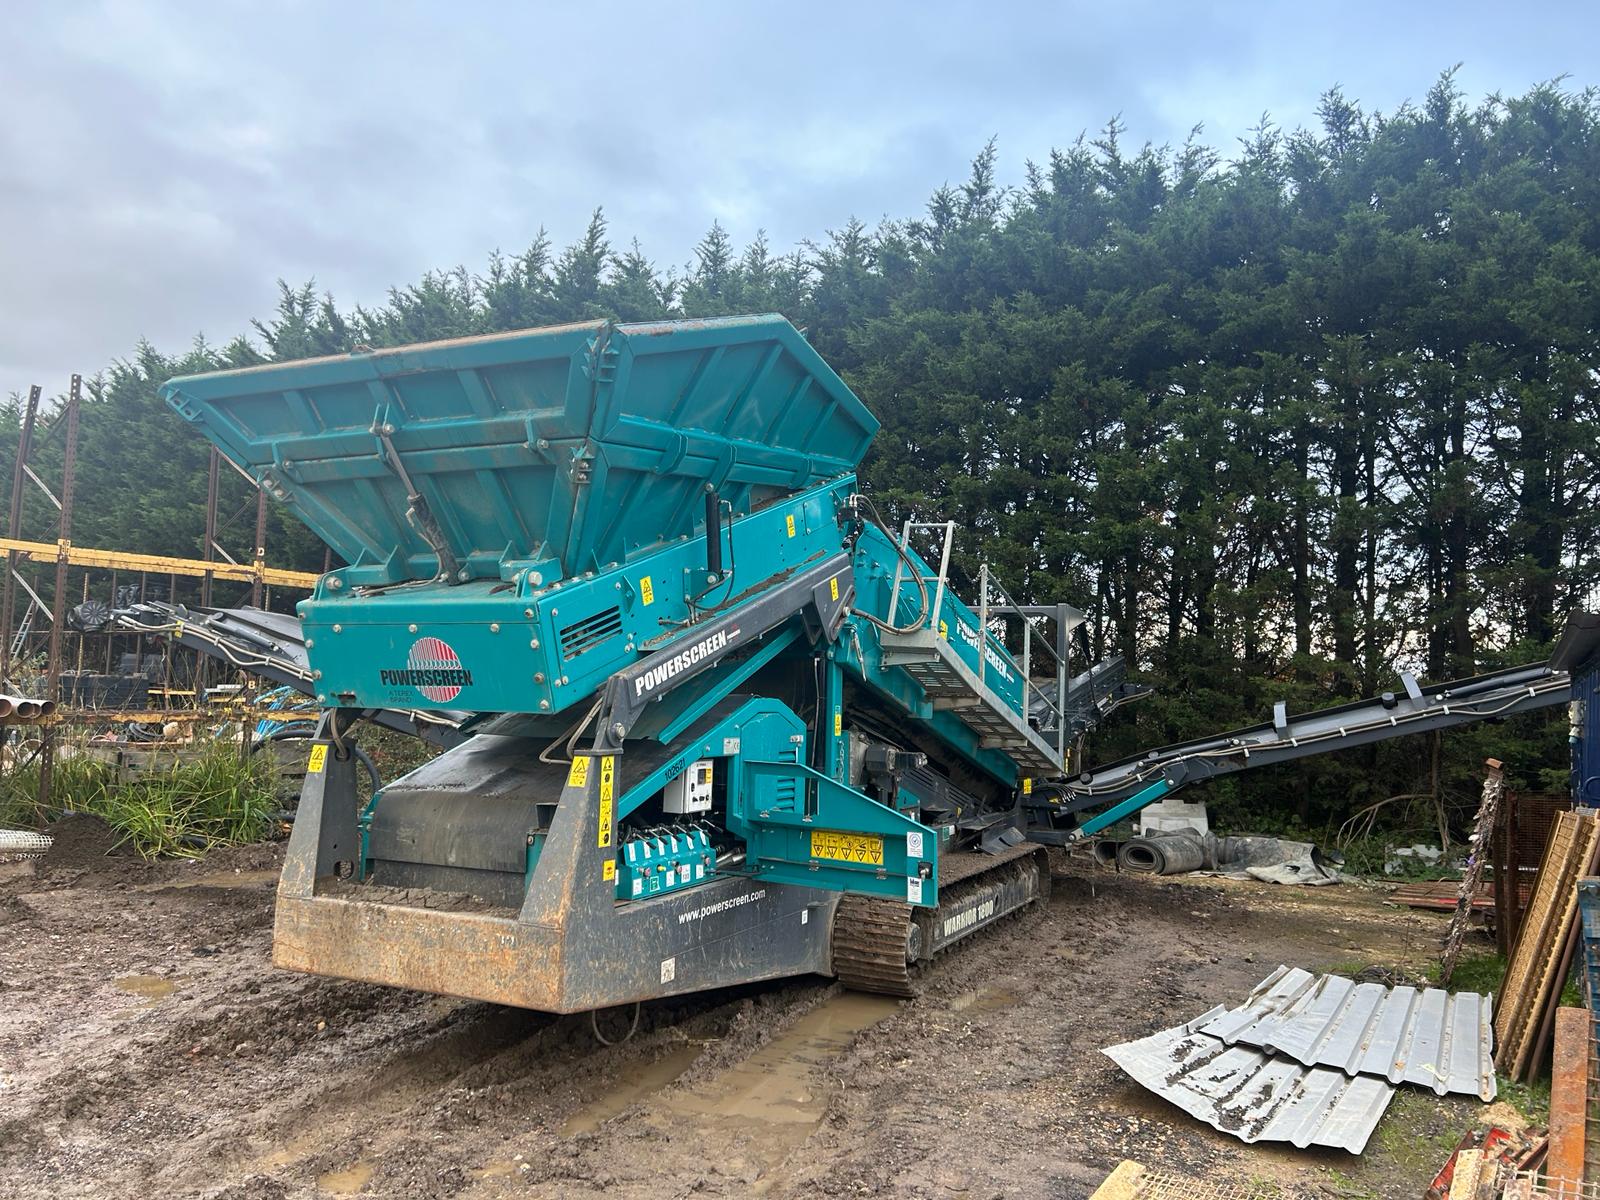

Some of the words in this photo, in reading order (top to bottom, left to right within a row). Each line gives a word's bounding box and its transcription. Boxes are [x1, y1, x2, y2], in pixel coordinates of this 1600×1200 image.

[380, 669, 473, 686] POWERSCREEN
[635, 629, 727, 697] POWERSCREEN
[664, 757, 686, 781] 102621
[678, 888, 766, 925] www.powerscreen.com
[944, 907, 977, 937] WARRIOR
